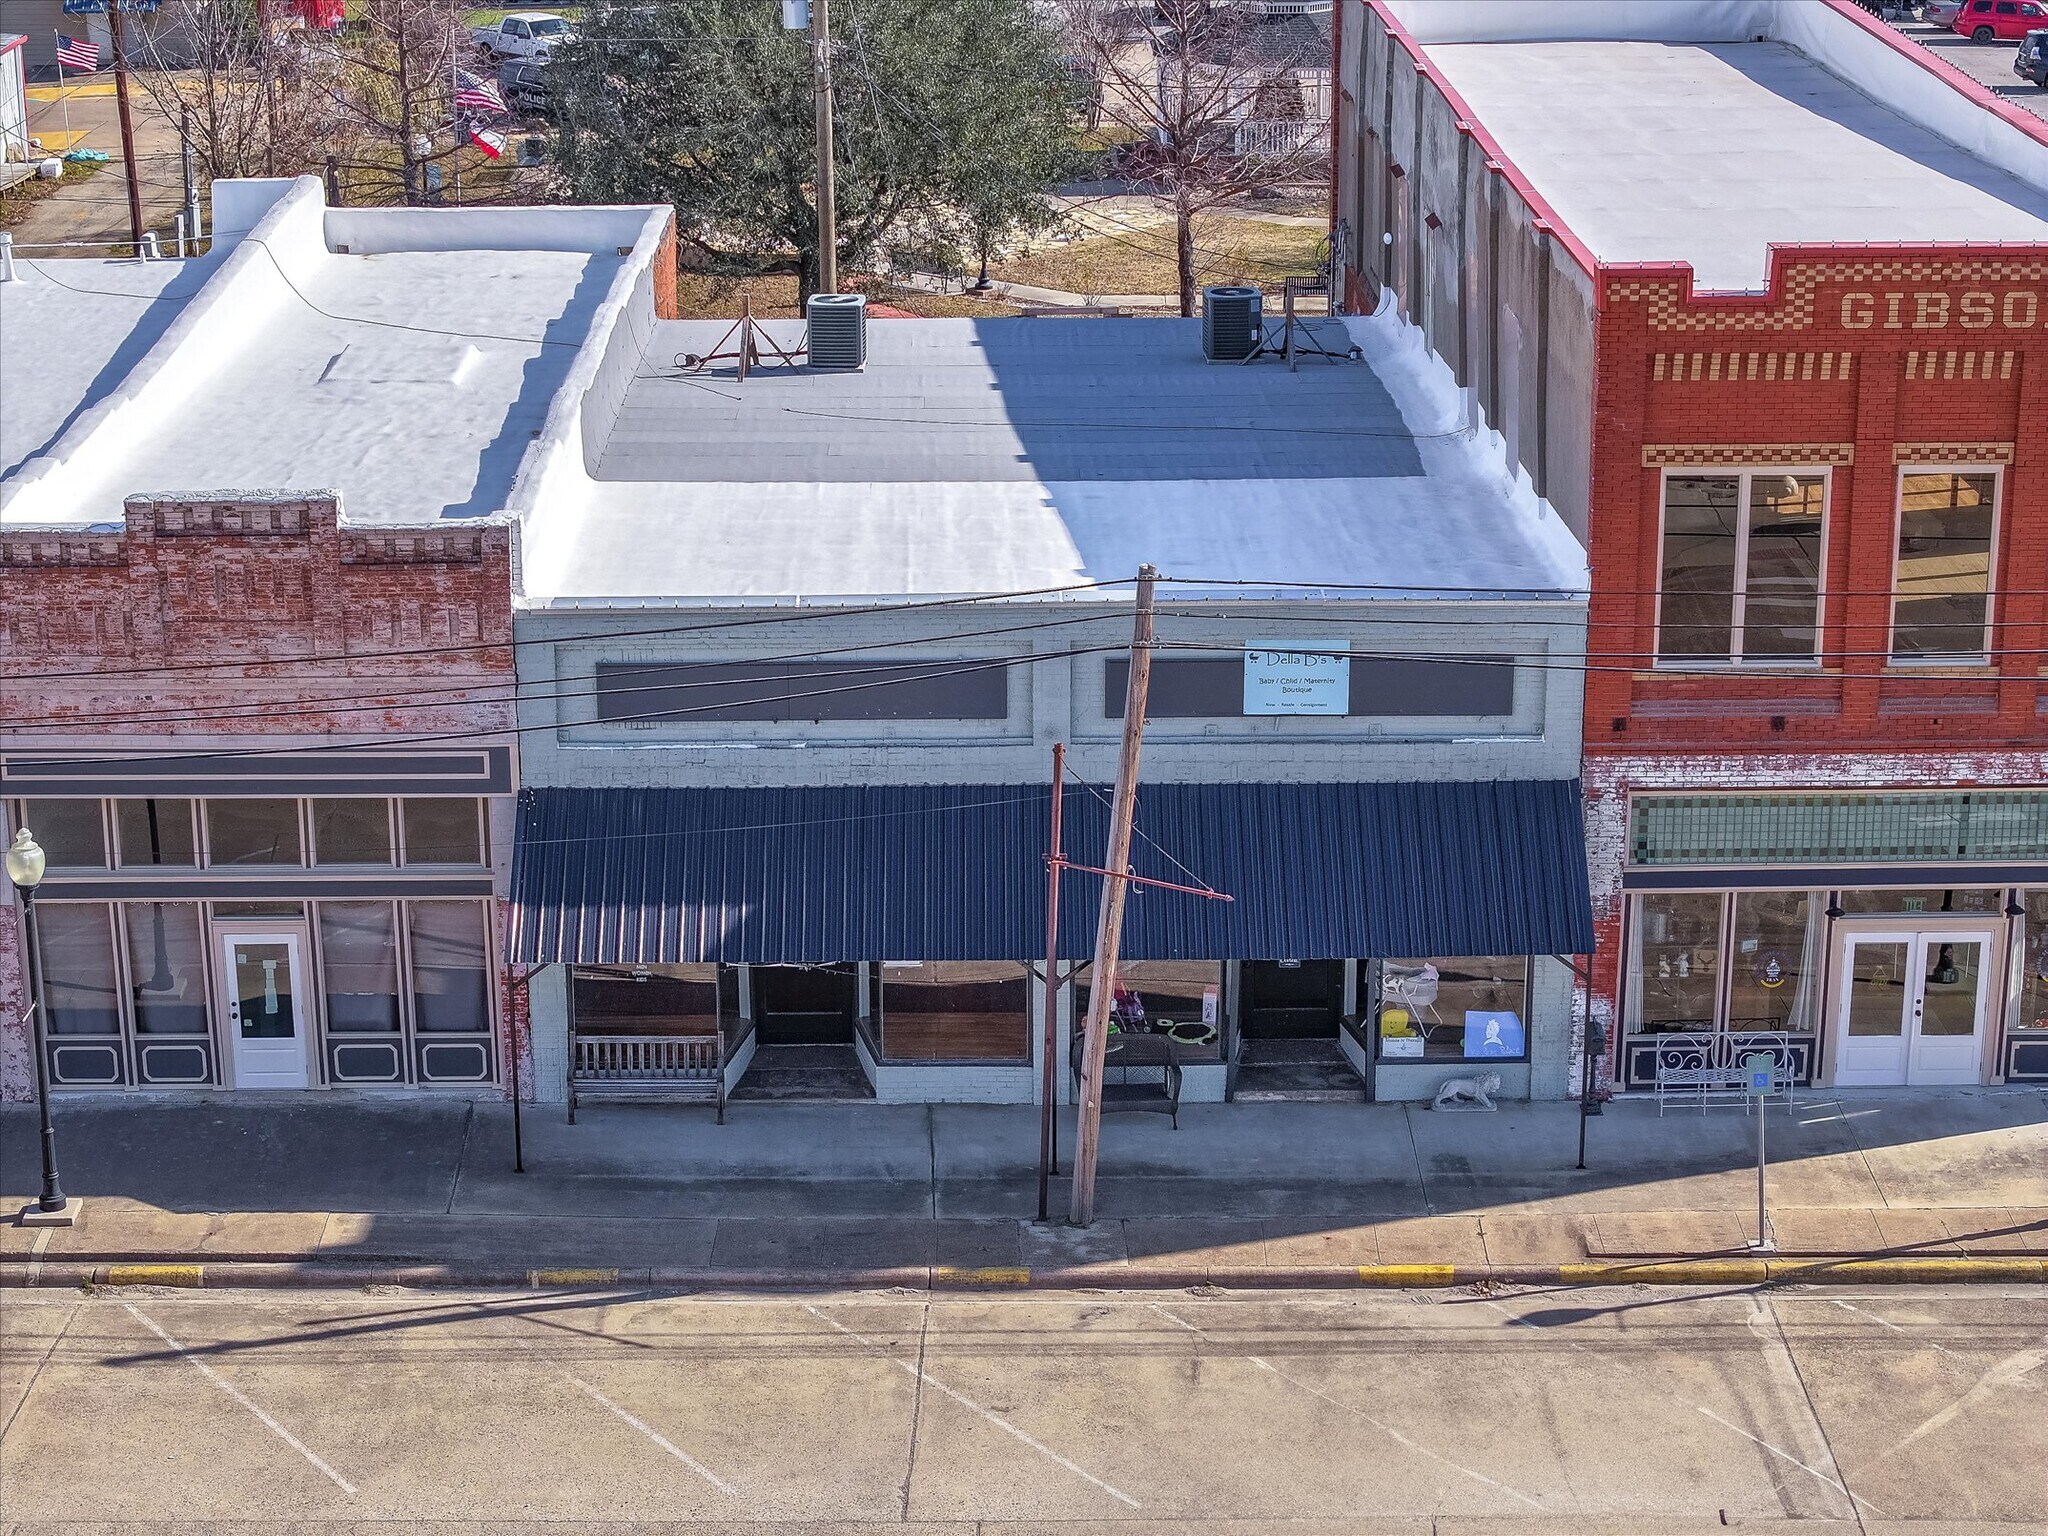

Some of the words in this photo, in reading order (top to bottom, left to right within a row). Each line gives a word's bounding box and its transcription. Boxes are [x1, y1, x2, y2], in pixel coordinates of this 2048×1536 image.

[519, 92, 546, 105] POLICE
[1840, 291, 2048, 329] GIBSO
[1266, 652, 1301, 666] Della
[1304, 654, 1328, 667] B's
[1258, 677, 1275, 685] Baby
[1280, 677, 1298, 685] Child
[1303, 677, 1336, 685] Maternity
[1282, 686, 1312, 694] Boutique
